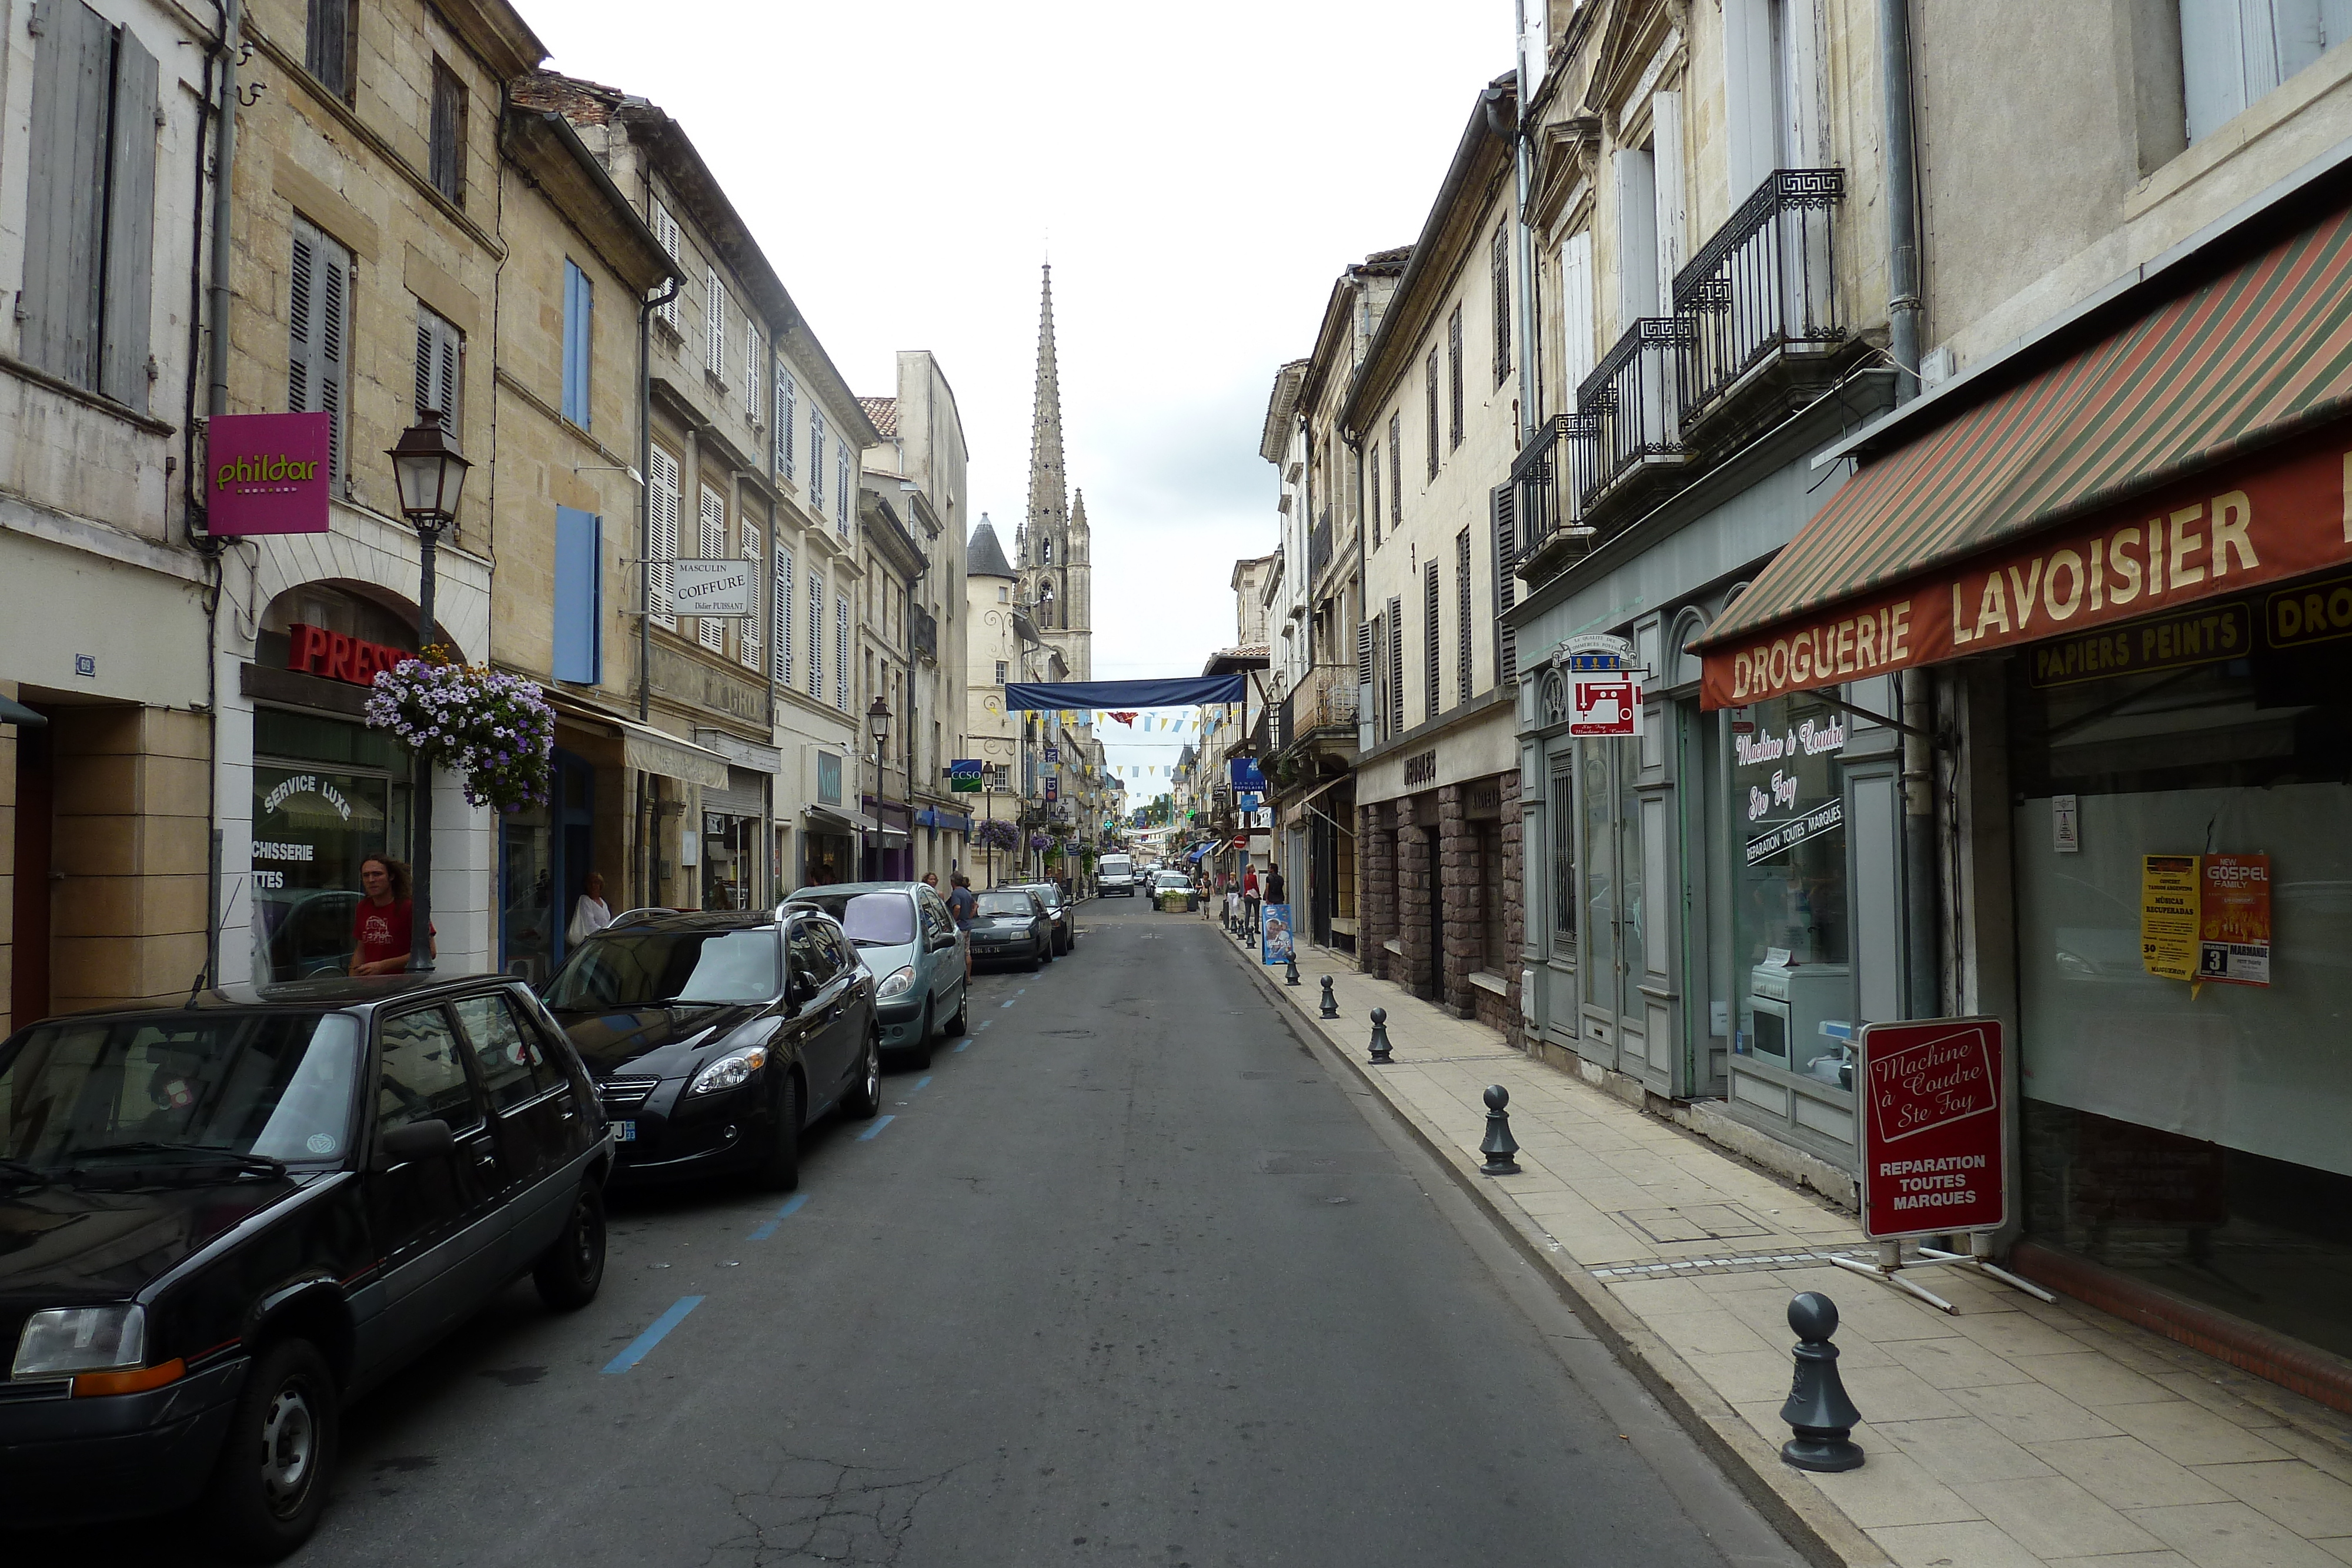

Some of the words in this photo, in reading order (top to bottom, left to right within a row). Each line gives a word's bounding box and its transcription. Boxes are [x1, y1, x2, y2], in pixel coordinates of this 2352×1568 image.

[216, 454, 319, 490] phildar
[1952, 490, 2260, 645] LAVOISIER
[678, 574, 746, 600] COIFFURE
[694, 601, 711, 610] Didier
[1732, 600, 1910, 698] DROGUERIE
[2037, 633, 2130, 680] PAPIERS
[2142, 612, 2236, 662] PEINTS
[82, 659, 90, 670] 69
[1736, 728, 1783, 766] Machine
[1786, 728, 1796, 756] à
[1799, 715, 1843, 755] Coudre
[951, 771, 981, 780] CCSO
[265, 775, 316, 814] SERVICE
[322, 781, 352, 822] LUXE
[1749, 785, 1769, 820] Ste
[1771, 768, 1798, 810] Foy
[1746, 833, 1780, 861] REPARATION
[1782, 821, 1805, 844] TOUTES
[1807, 804, 1842, 833] MARQUES
[2207, 865, 2269, 881] GOSPEL
[2220, 858, 2237, 867] NEW
[2213, 880, 2248, 889] FAMILY
[2143, 944, 2156, 953] 30
[2230, 945, 2268, 958] MARMANDE
[2209, 951, 2221, 970] 3
[1876, 1045, 1973, 1082] Machine
[1882, 1090, 1896, 1108] à
[1903, 1063, 1984, 1096] Coudre
[1897, 1104, 1932, 1128] Ste
[1935, 1089, 1977, 1115] Foy
[626, 1131, 635, 1139] 33
[1880, 1155, 1986, 1177] REPARATION
[1899, 1174, 1966, 1192] TOUTES
[1893, 1190, 1976, 1211] MARQUES
